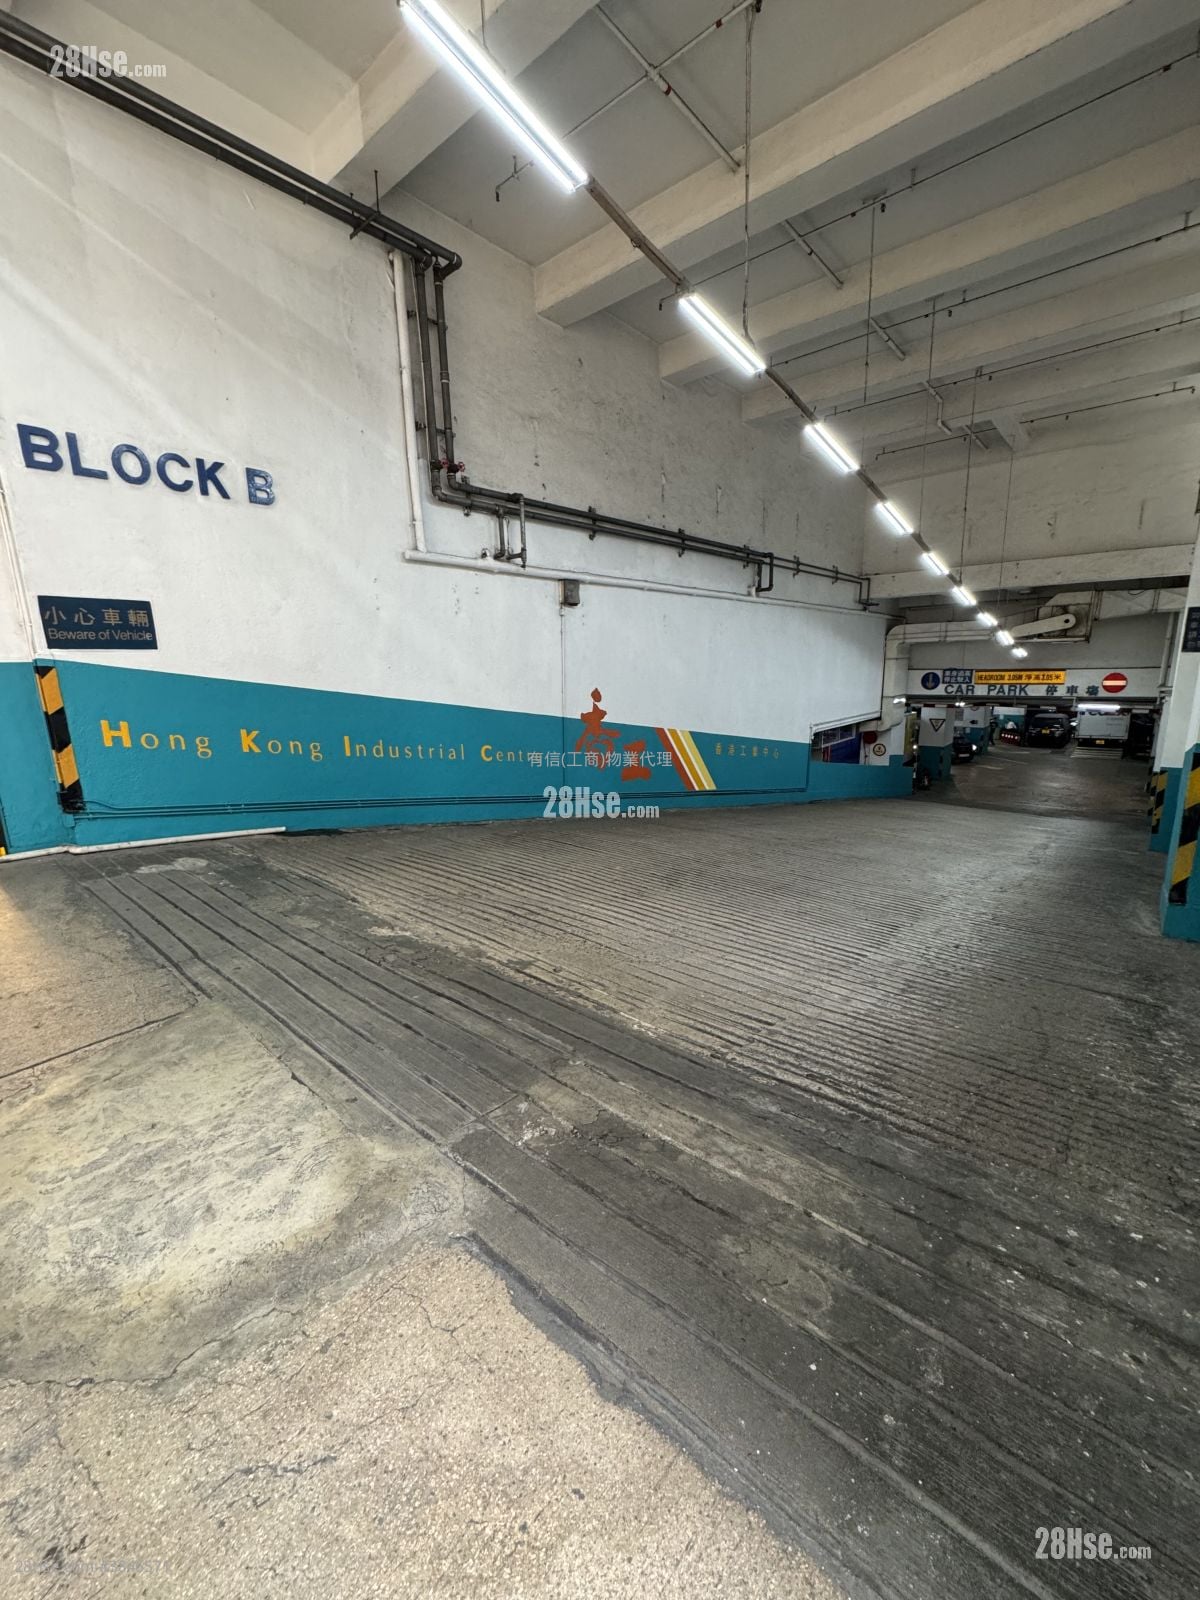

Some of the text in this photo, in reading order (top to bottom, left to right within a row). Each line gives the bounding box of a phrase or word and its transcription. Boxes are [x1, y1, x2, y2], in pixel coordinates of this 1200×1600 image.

[17, 423, 276, 506] BLOCK B
[44, 606, 150, 628] 小心車輛
[48, 628, 153, 641] Beware of Vehicle
[944, 684, 975, 695] CAR
[987, 684, 1029, 696] PARK
[100, 719, 213, 760] Hong
[240, 728, 324, 762] Kong
[343, 735, 466, 761] Industrial
